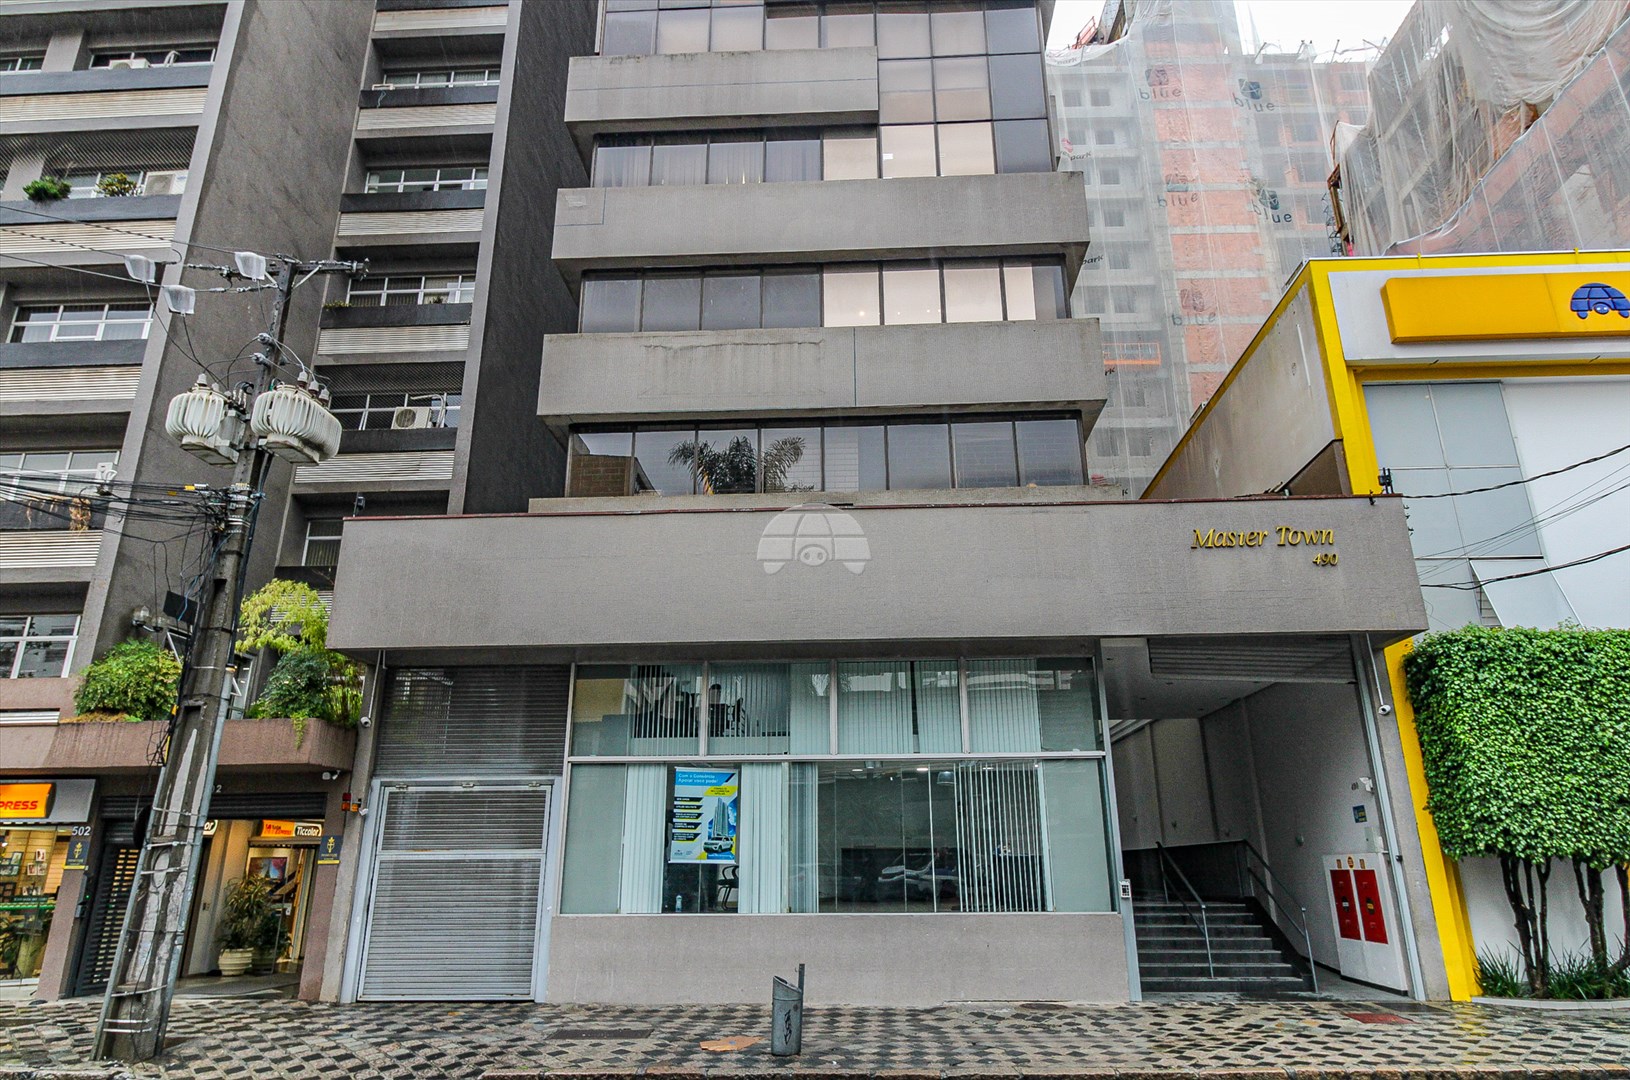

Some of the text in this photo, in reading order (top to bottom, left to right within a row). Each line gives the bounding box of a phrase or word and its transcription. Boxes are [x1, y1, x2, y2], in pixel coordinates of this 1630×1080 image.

[1138, 87, 1182, 100] blue
[1232, 92, 1275, 113] blue
[1157, 192, 1199, 207] blue
[1251, 199, 1293, 224] blue
[1171, 312, 1216, 326] blue
[1191, 524, 1334, 549] Master Town
[1312, 552, 1339, 566] 490
[71, 826, 91, 836] 502
[296, 826, 319, 837] Ticcolor
